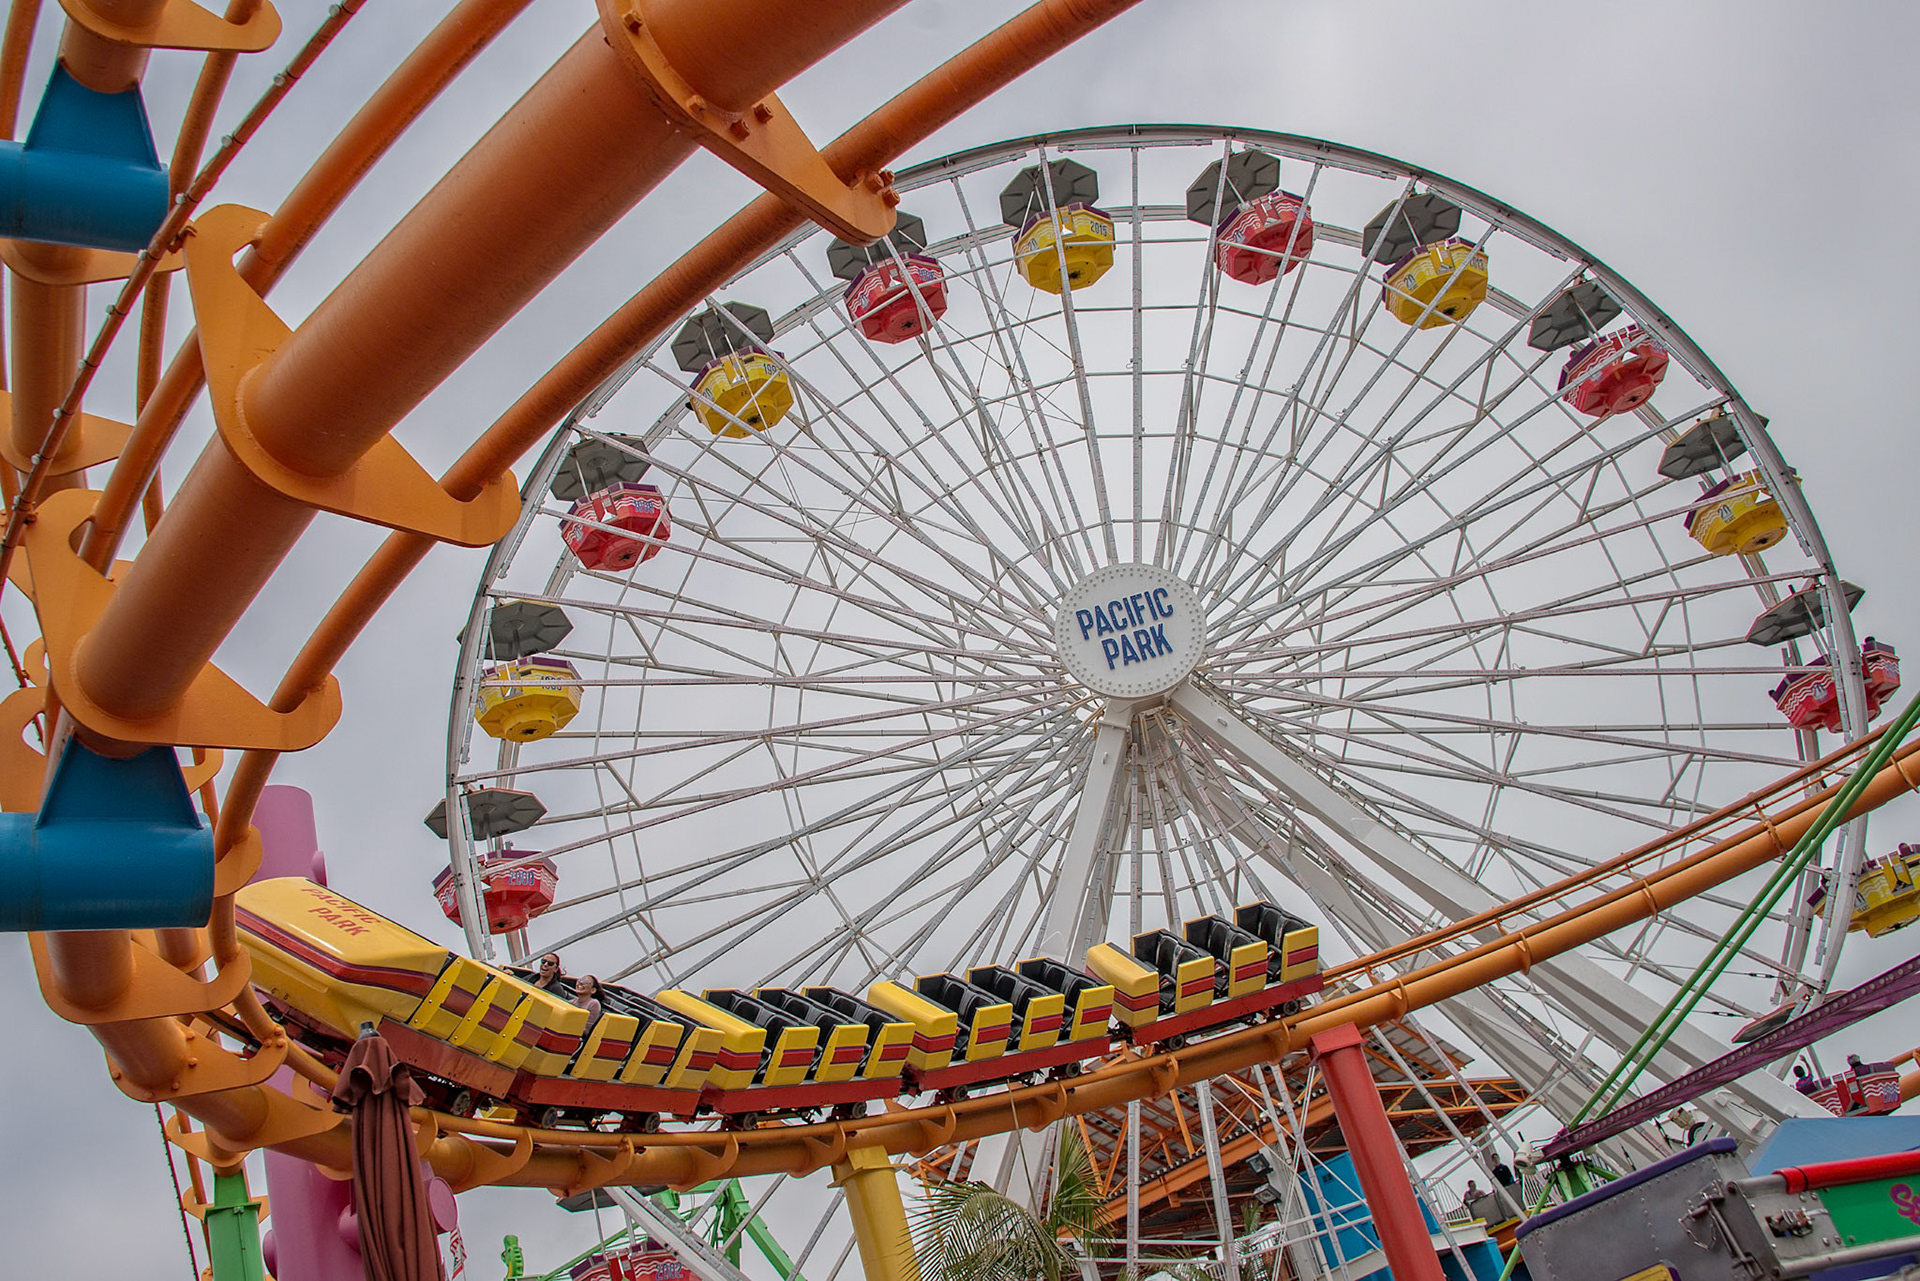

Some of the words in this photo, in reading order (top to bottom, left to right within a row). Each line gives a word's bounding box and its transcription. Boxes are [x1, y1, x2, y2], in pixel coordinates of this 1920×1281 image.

[1075, 587, 1174, 640] PACIFIC
[1101, 623, 1173, 670] PARK
[300, 886, 382, 925] PACIFIC
[308, 906, 371, 937] PARK
